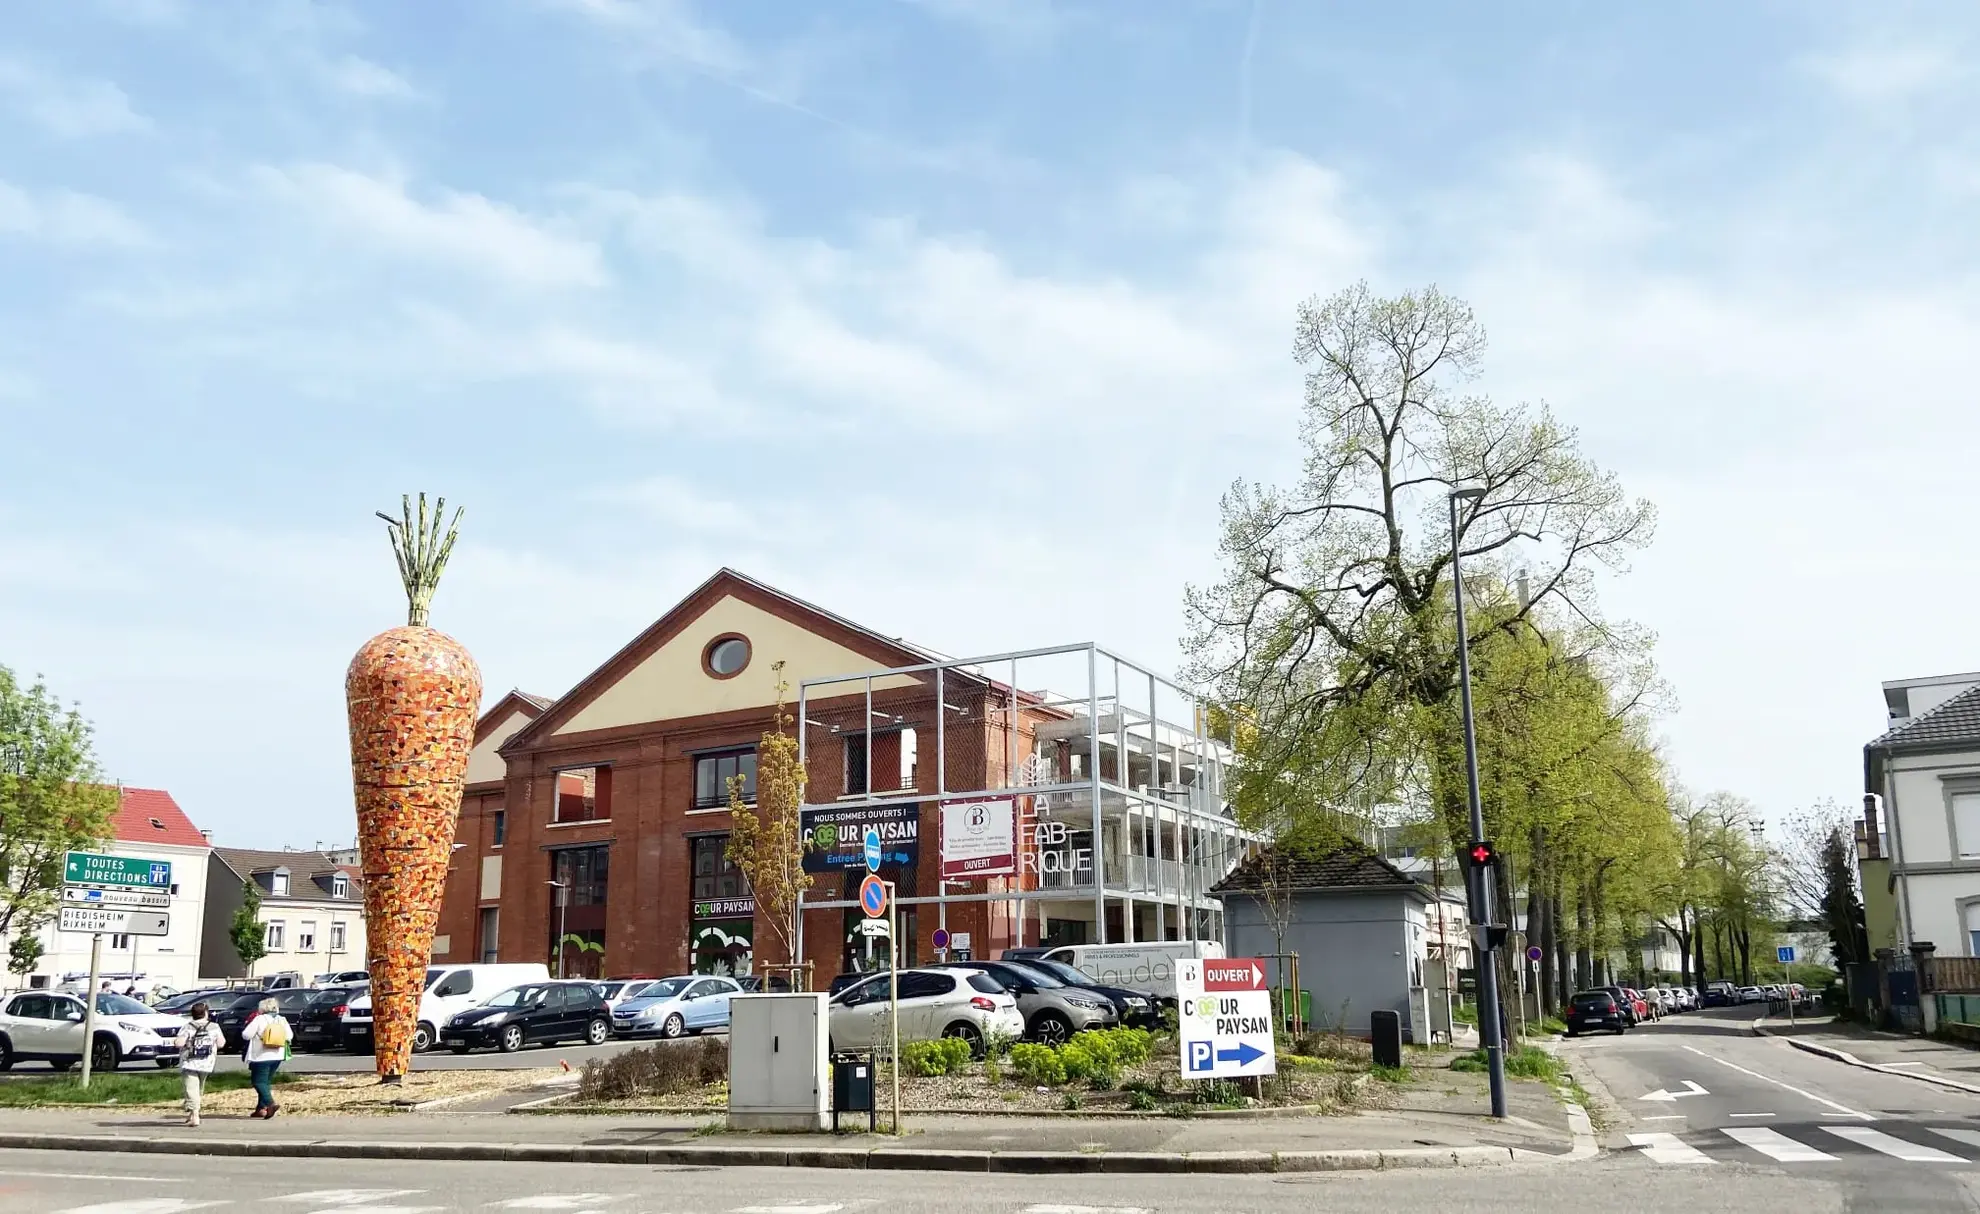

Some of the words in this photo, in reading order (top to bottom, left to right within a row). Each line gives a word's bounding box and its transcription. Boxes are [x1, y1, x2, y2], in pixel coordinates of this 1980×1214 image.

[814, 814, 834, 823] NOUS
[836, 811, 866, 821] SOMMES
[868, 809, 902, 819] OUVERTS
[862, 820, 917, 841] PAYSAN
[86, 857, 125, 870] TOUTES
[964, 858, 991, 870] OUVERT
[1020, 848, 1093, 874] RIQUE
[84, 869, 148, 883] DIRECTIONS
[103, 894, 138, 903] nouveau
[141, 893, 168, 905] bassin
[723, 901, 754, 913] PAYSAN
[64, 910, 124, 921] RIEDISHEIM
[63, 921, 106, 929] RIXHEIM
[1207, 969, 1250, 982] OUVERT
[1216, 1016, 1268, 1035] PAYSAN
